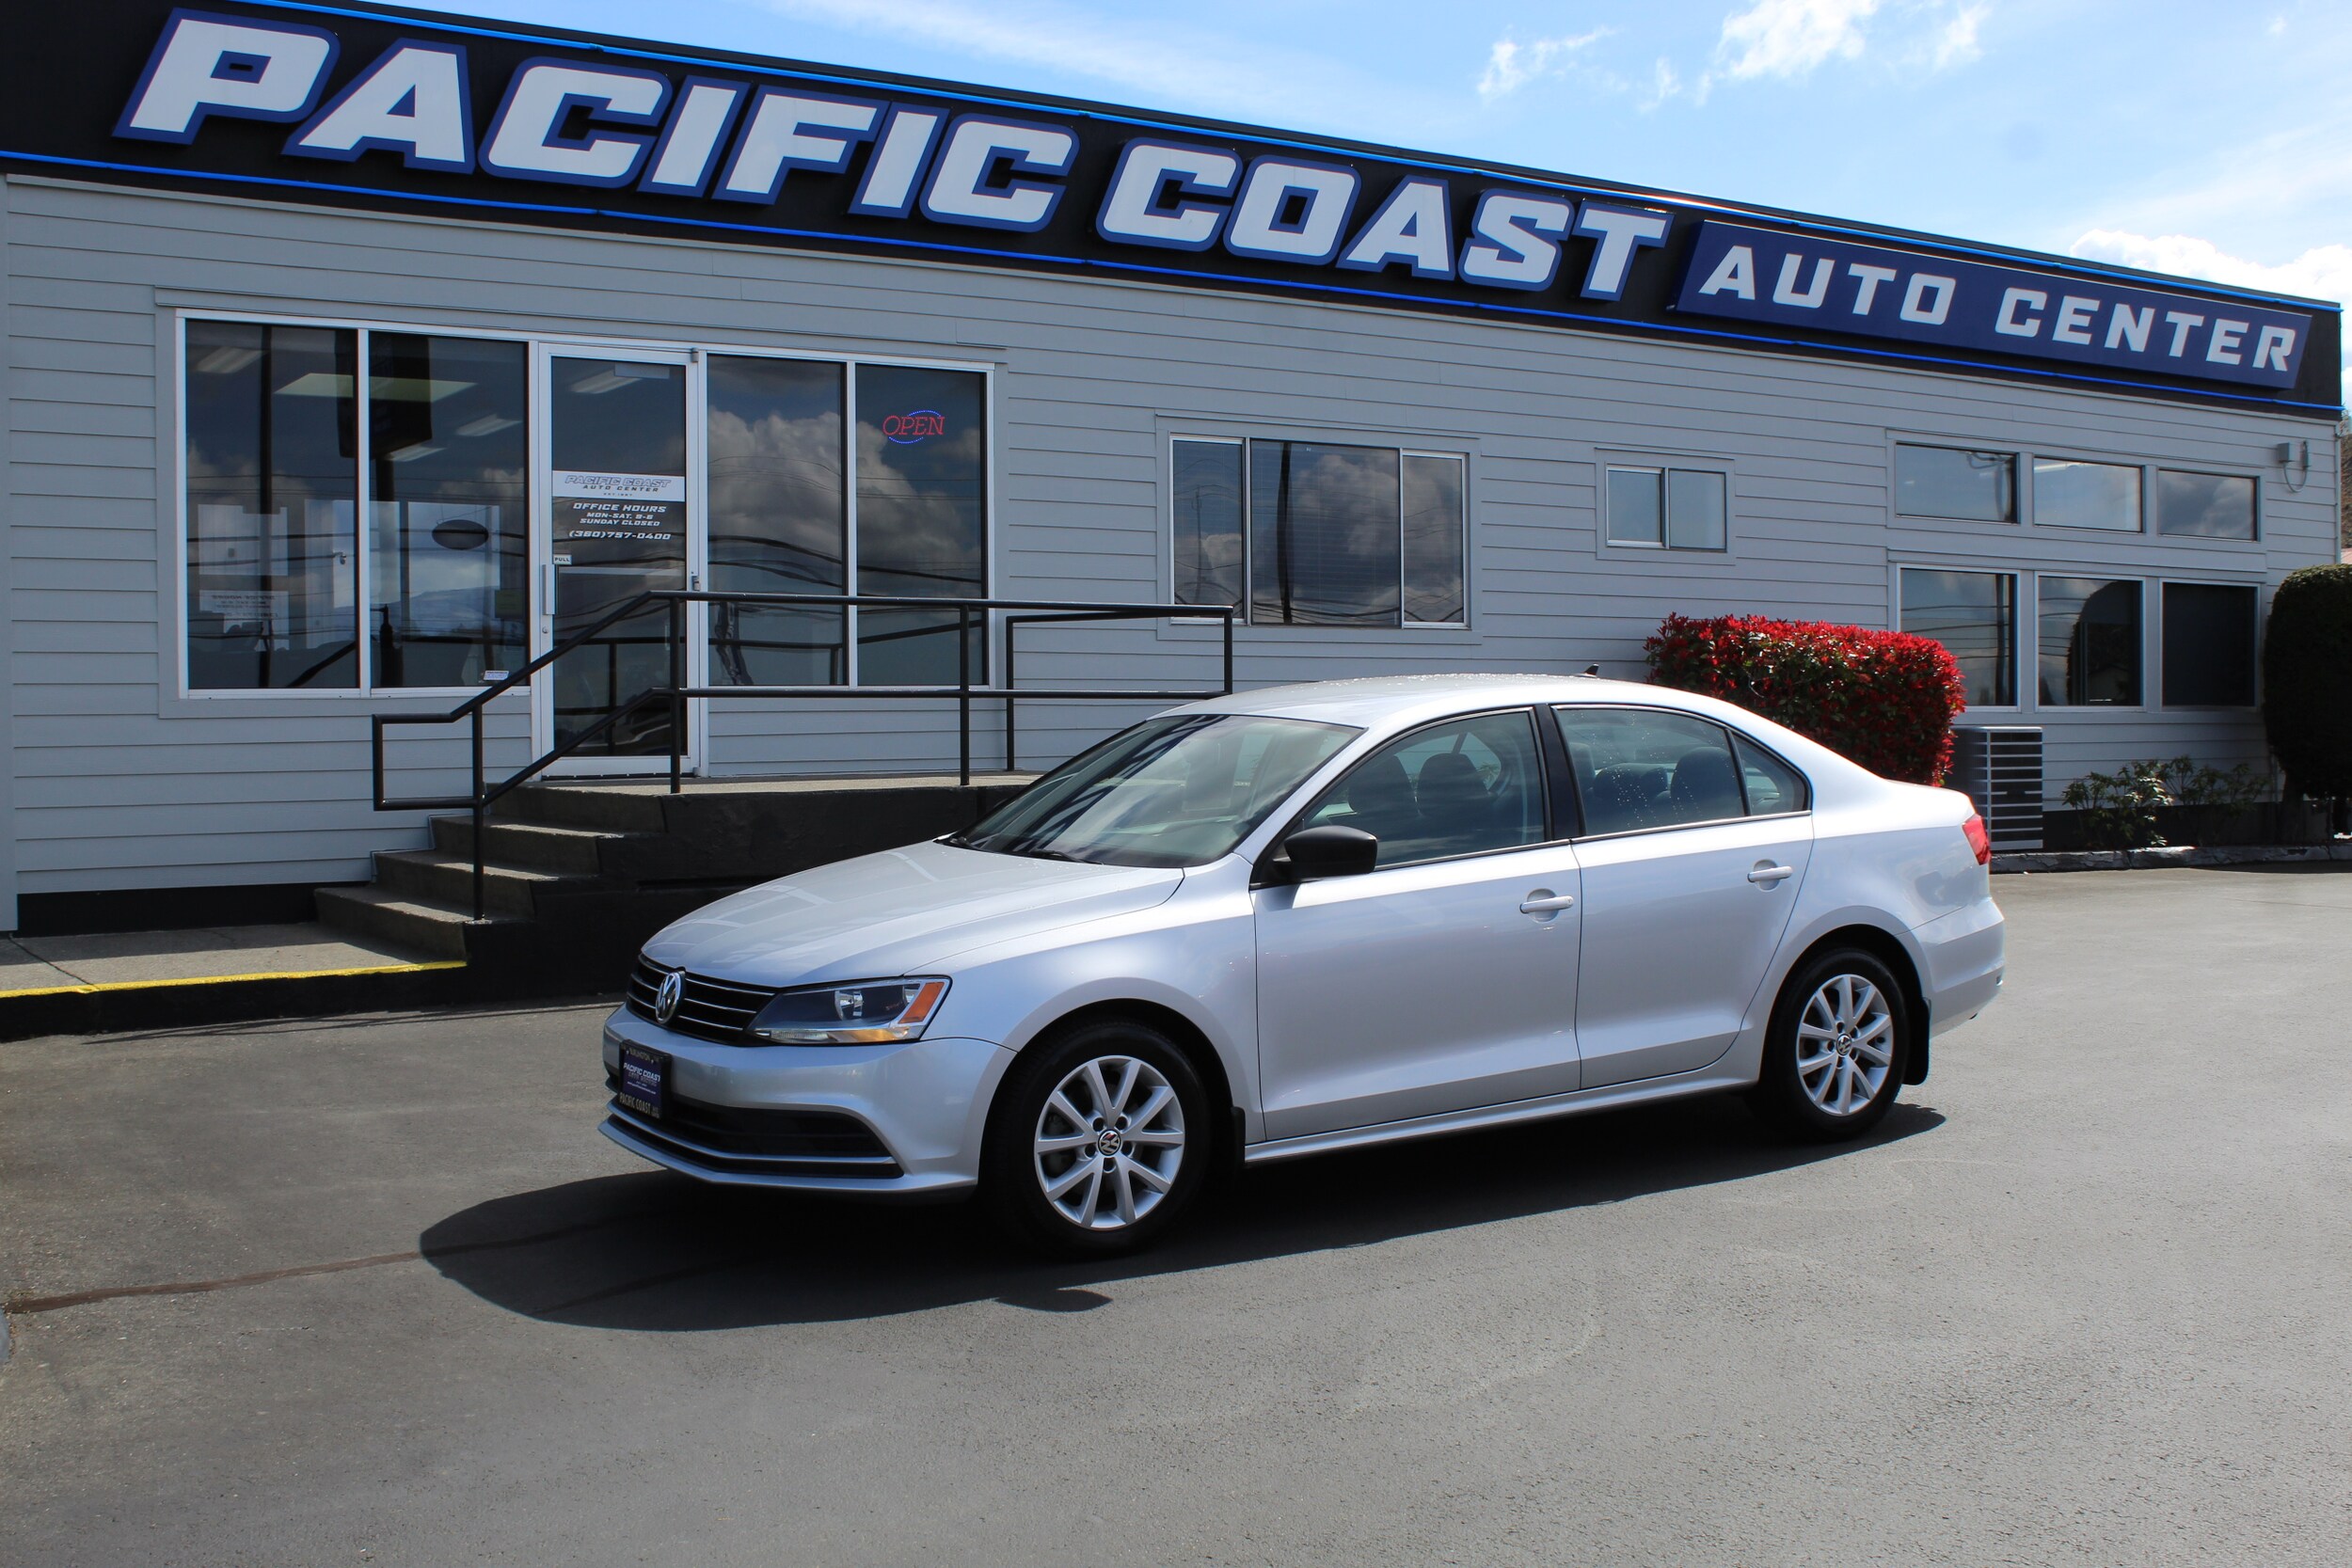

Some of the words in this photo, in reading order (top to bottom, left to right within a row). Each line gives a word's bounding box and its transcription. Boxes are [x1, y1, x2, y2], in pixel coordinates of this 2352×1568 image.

[112, 8, 1080, 232] PACIFIC
[1096, 137, 1674, 301] COAST
[1698, 245, 1957, 326] AUTO
[1994, 287, 2296, 372] CENTER
[882, 415, 946, 436] OPEN
[565, 475, 621, 485] PACIFIC
[623, 477, 671, 487] COAST
[573, 502, 620, 512] OFFICE
[622, 504, 667, 513] HOURS
[623, 1062, 643, 1076] PACIFIC
[643, 1069, 660, 1083] COAST
